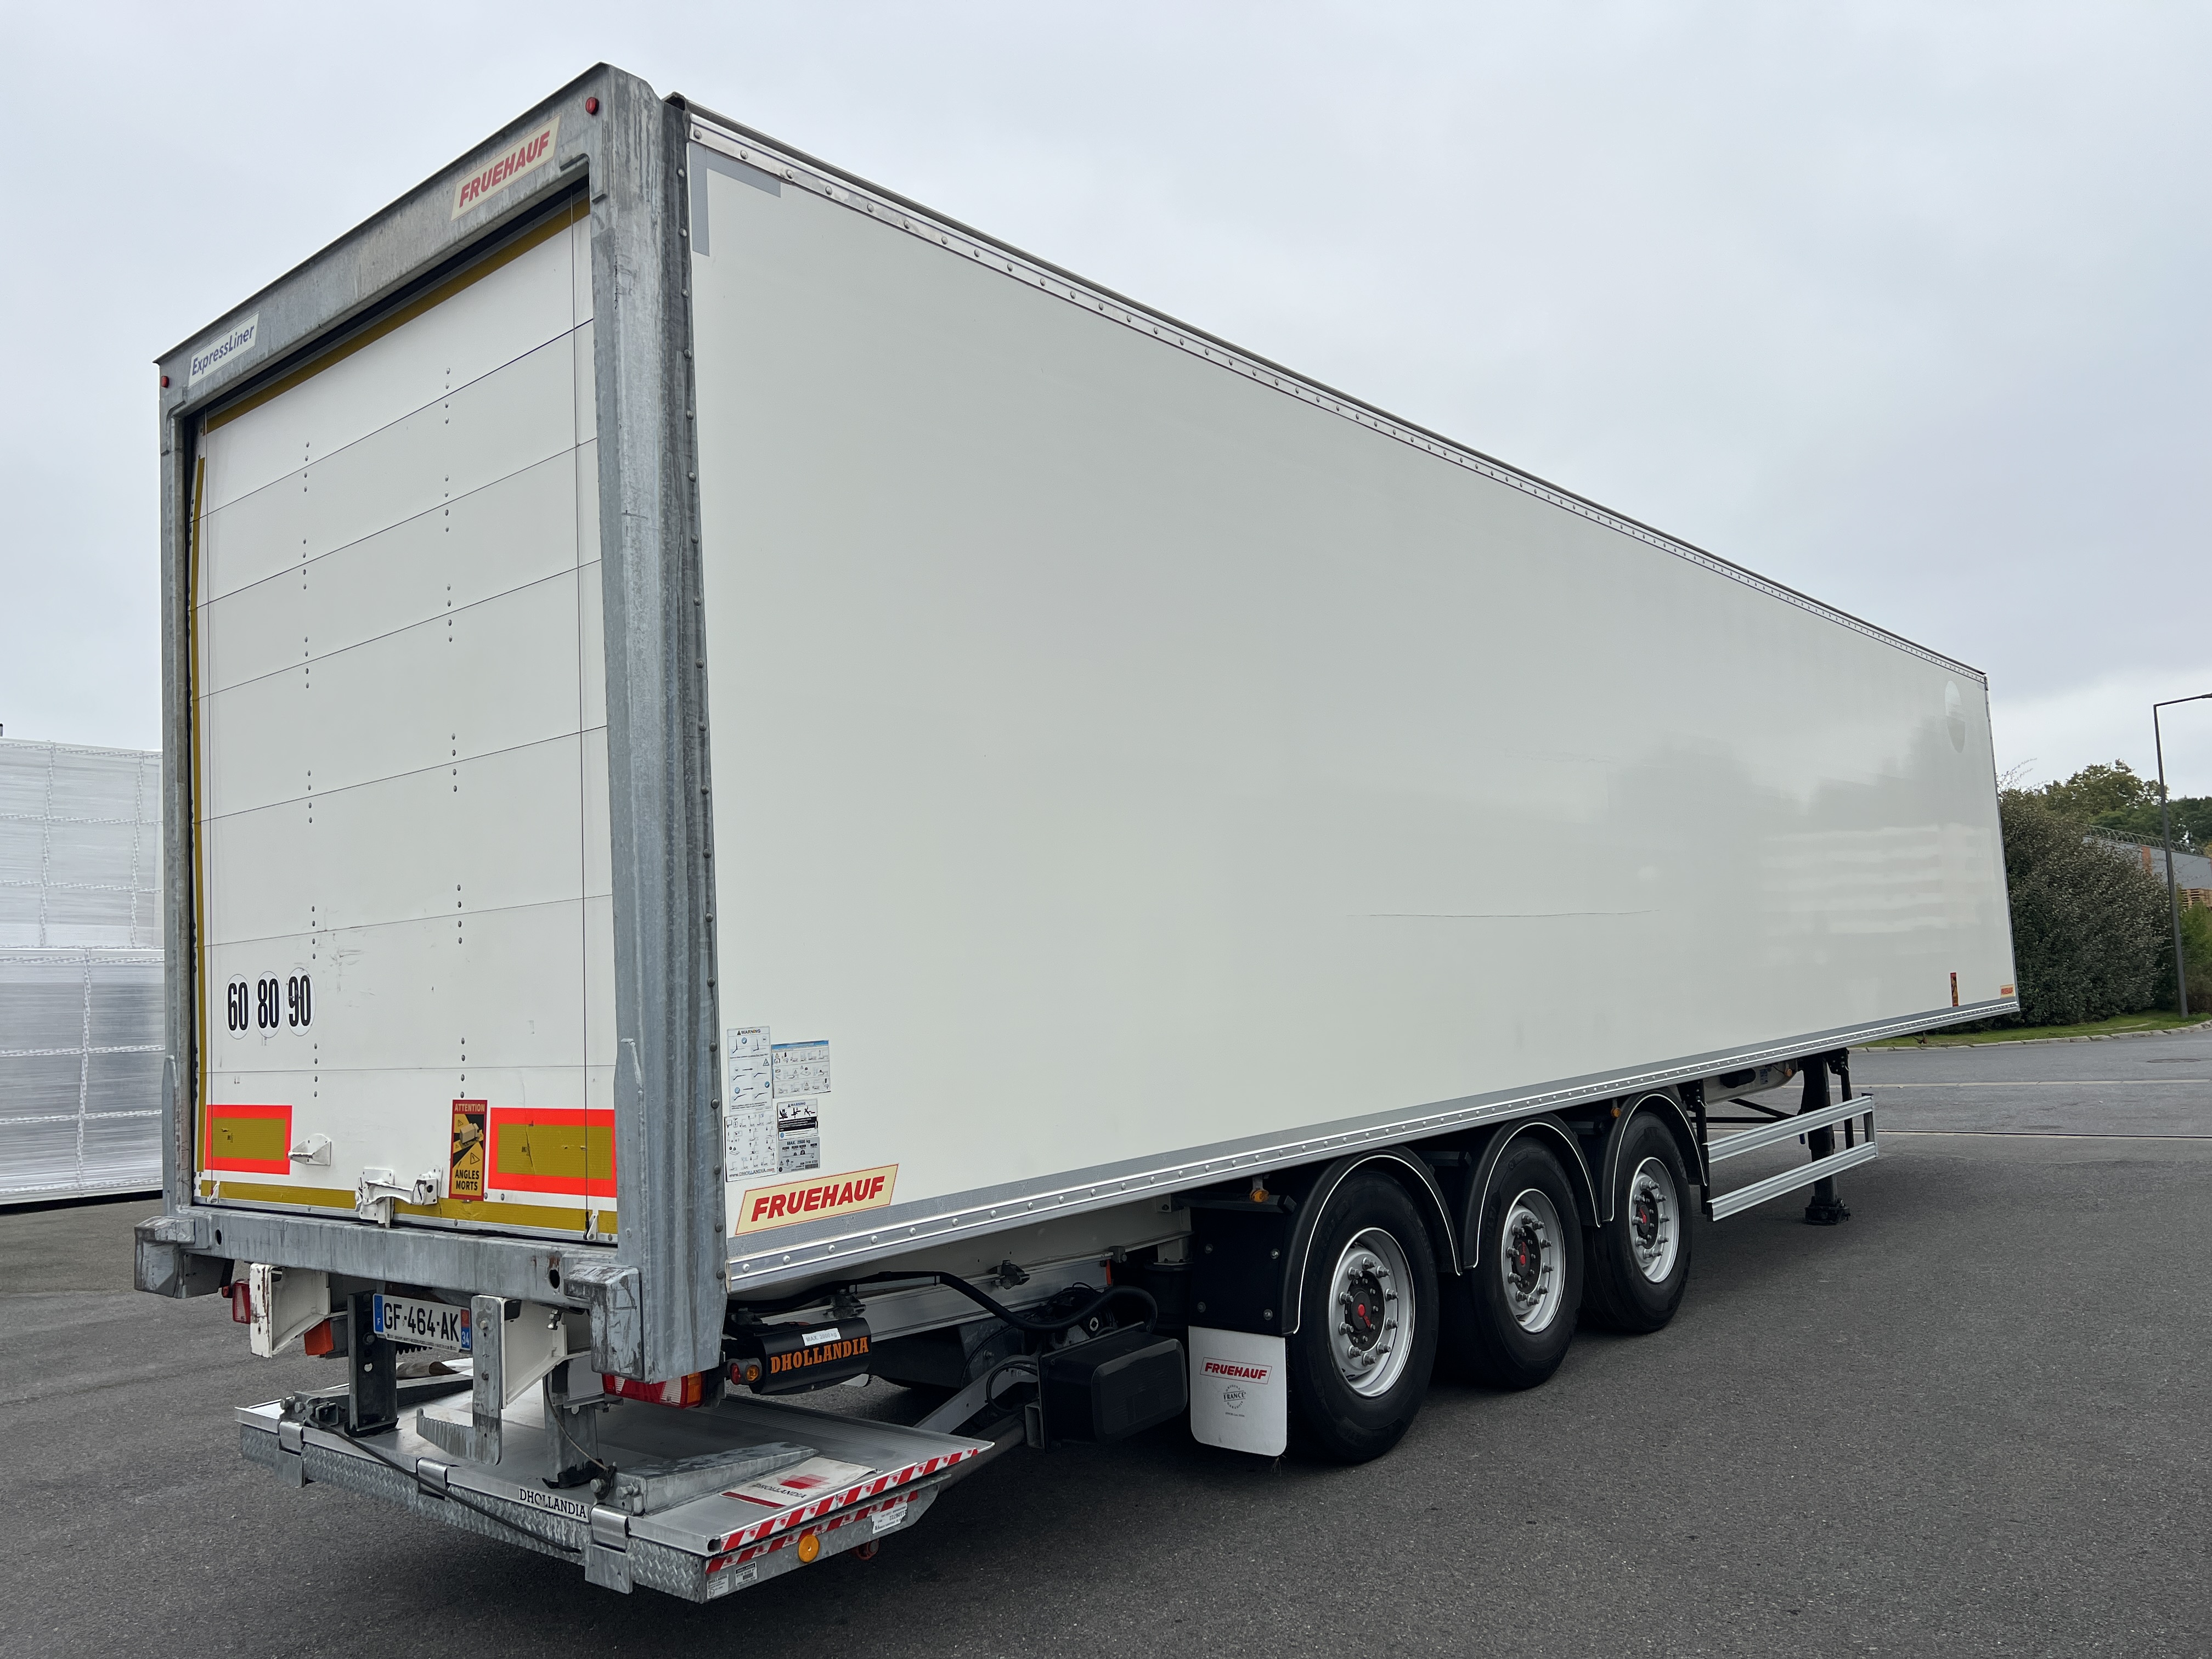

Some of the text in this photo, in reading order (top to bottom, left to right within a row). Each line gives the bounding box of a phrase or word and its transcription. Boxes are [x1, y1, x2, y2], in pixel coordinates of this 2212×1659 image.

[459, 129, 550, 208] FRUEHAUF
[192, 325, 255, 376] ExpressLiner
[228, 981, 248, 1031] 60
[257, 978, 279, 1029] 80
[288, 975, 311, 1027] 90
[454, 1103, 486, 1112] ATTENTION
[454, 1169, 479, 1180] ANGLES
[455, 1180, 478, 1191] MORTS
[729, 1167, 775, 1178] www.DHOLLANDIA.com
[751, 1176, 885, 1222] FRUEHAUF
[377, 1317, 381, 1326] F
[383, 1302, 460, 1342] GF-464-AK
[461, 1331, 470, 1345] 34
[770, 1336, 869, 1374] DHOLLANDIA
[1205, 1362, 1267, 1380] FRUEHAUF
[519, 1488, 587, 1519] DHOLLANDIA
[752, 1482, 808, 1499] DHOLLANDIA
